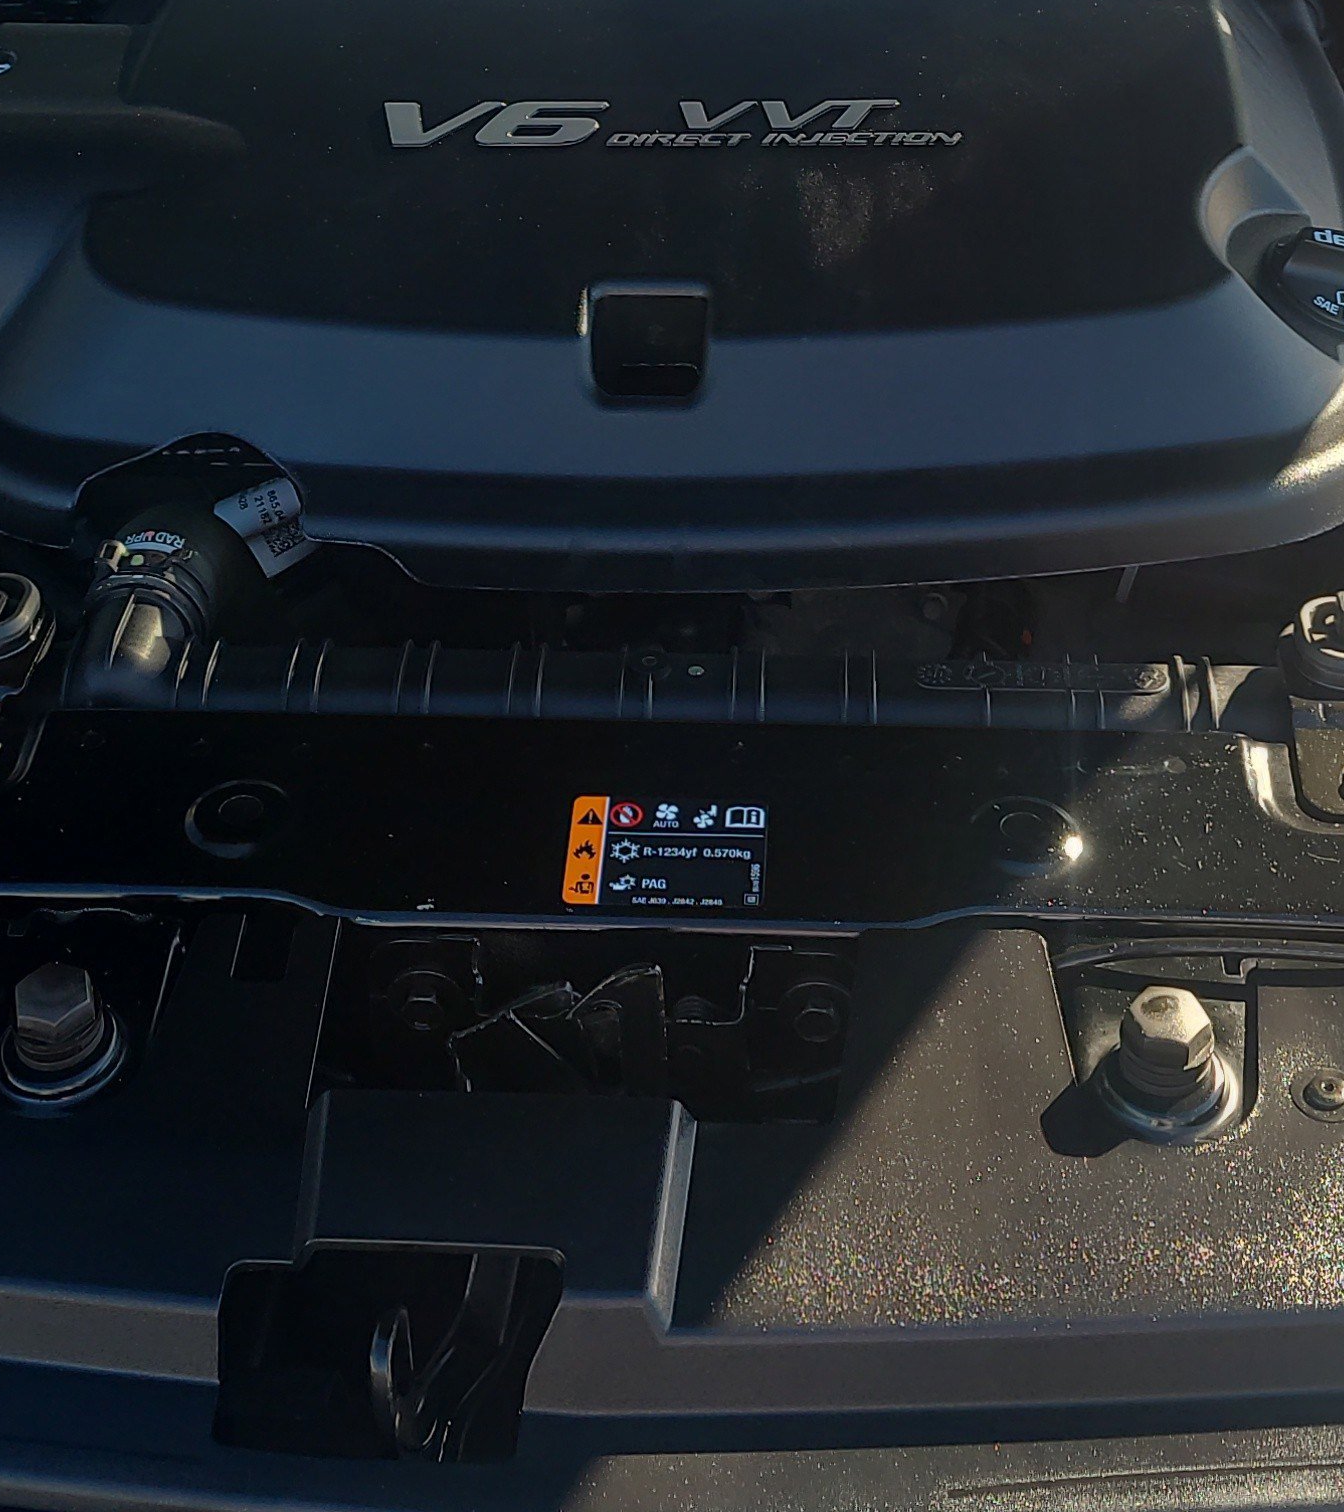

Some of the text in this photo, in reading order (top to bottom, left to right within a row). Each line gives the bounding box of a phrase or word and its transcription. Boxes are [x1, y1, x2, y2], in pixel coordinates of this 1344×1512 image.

[383, 99, 900, 147] V6 VVT
[604, 132, 963, 148] DIRECT INJECTION
[1313, 295, 1339, 316] SAE
[155, 532, 186, 549] RAD
[653, 820, 679, 828] AUTO
[642, 846, 752, 860] R-1234yf 0.570kg
[641, 878, 667, 889] PAG
